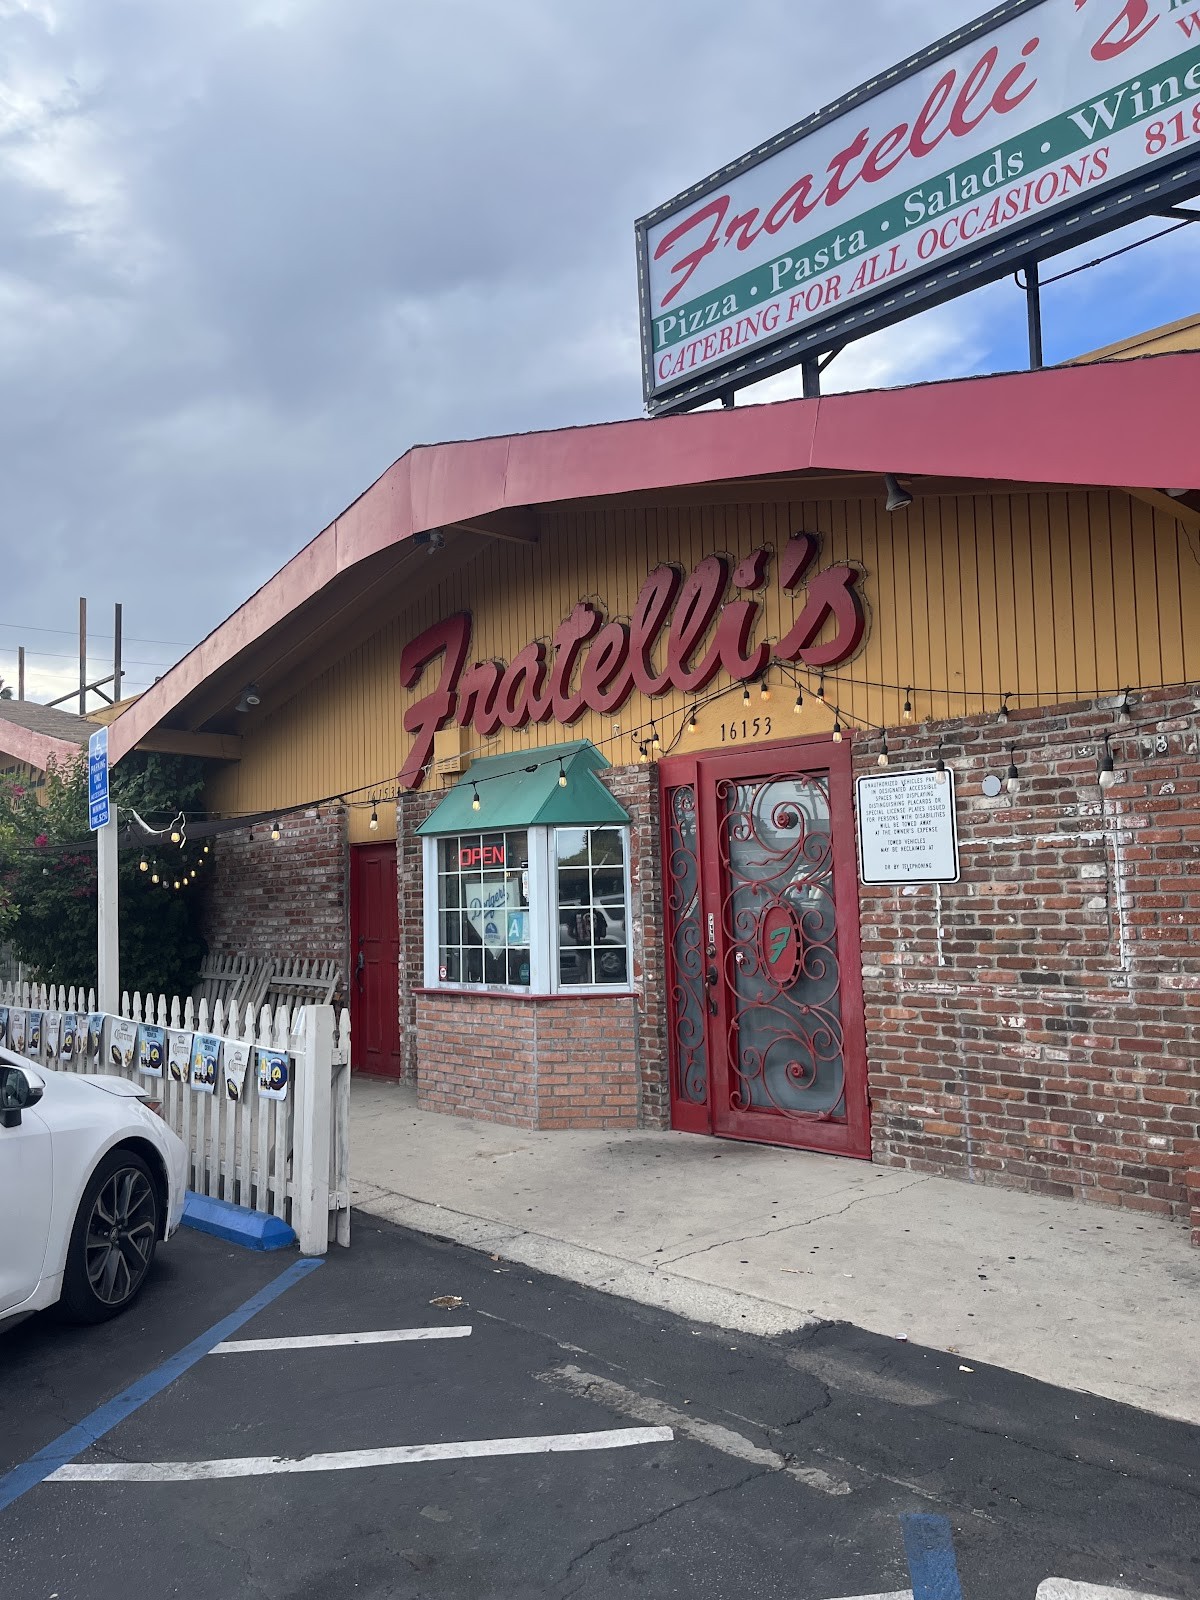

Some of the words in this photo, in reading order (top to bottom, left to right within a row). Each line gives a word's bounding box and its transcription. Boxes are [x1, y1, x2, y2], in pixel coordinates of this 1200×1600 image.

[653, 0, 1160, 308] Fratellis
[656, 293, 738, 348] Pizza
[769, 228, 868, 294] Pasta
[903, 148, 1024, 228] Salads
[658, 303, 780, 380] CATERING
[786, 275, 841, 323] FOR
[848, 244, 908, 295] ALL
[917, 146, 1110, 260] OCCASIONS
[398, 531, 866, 789] Fratelli's
[721, 717, 771, 741] 16153
[902, 778, 922, 786] VEHICLES
[459, 845, 504, 866] OPEN
[508, 918, 520, 937] A
